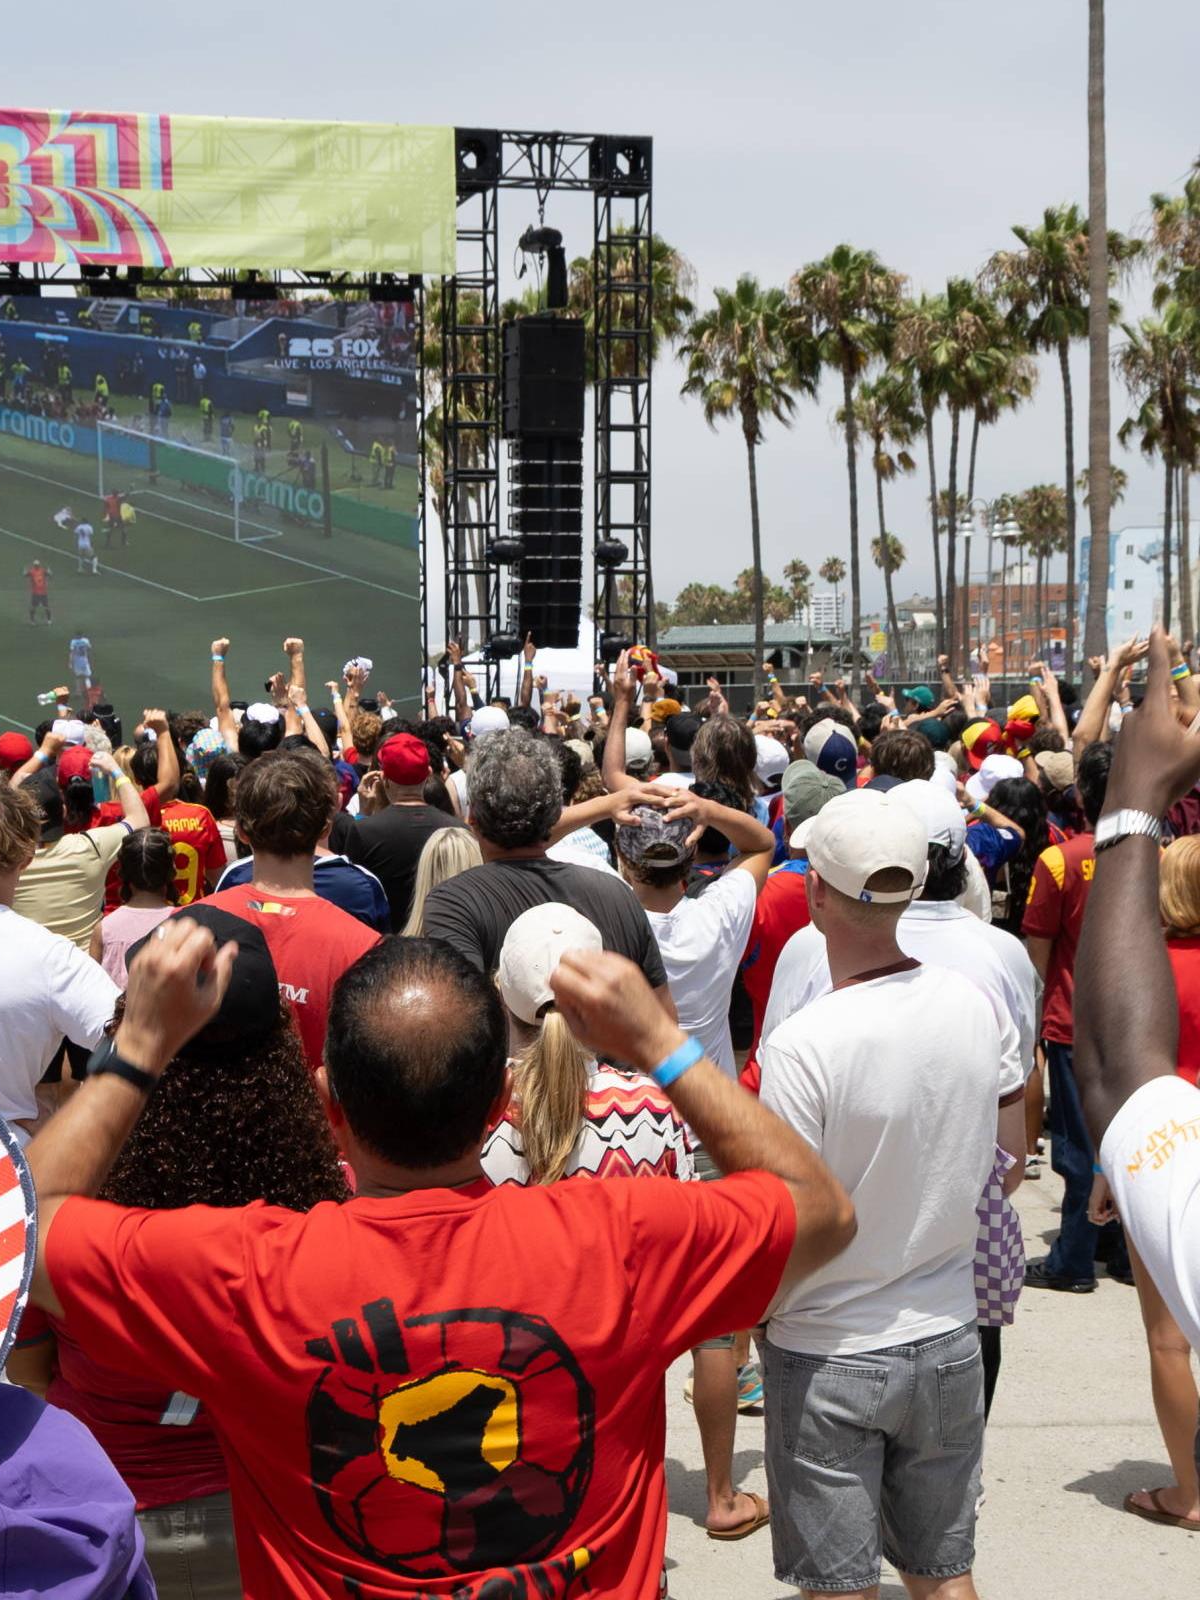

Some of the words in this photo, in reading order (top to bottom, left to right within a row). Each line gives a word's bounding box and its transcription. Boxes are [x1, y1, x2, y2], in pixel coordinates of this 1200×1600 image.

[341, 338, 381, 357] FOX
[274, 359, 298, 369] LIVE
[310, 359, 332, 369] LOS
[335, 359, 386, 370] ANGELES
[228, 468, 324, 519] aramco
[835, 758, 848, 771] C
[165, 818, 204, 832] YAMAL
[173, 842, 199, 905] 9
